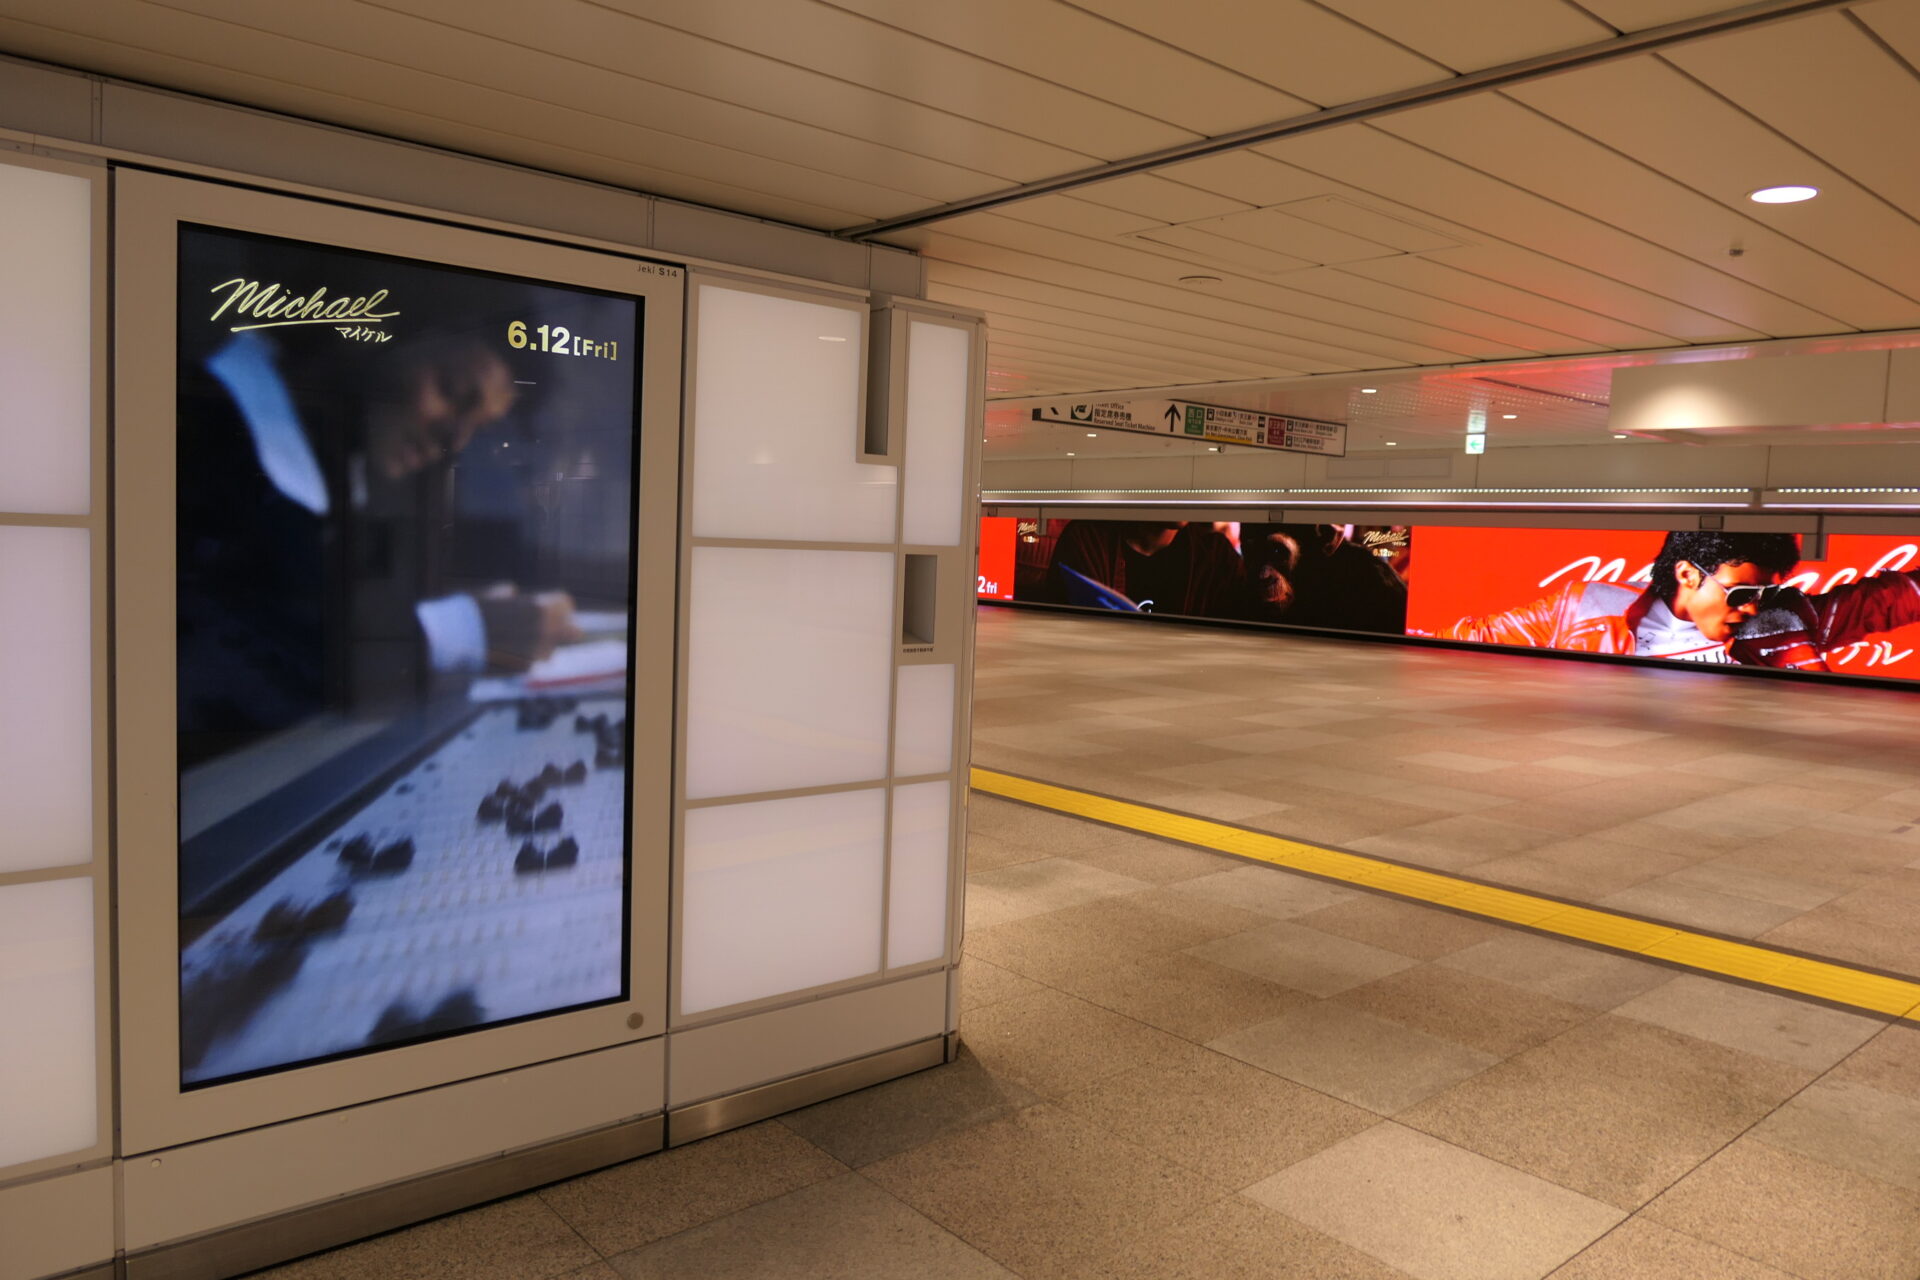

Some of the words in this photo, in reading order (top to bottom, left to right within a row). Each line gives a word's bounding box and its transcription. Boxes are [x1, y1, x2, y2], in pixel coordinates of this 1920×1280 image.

[658, 266, 678, 278] S14
[210, 278, 401, 326] Michael
[334, 325, 393, 344] マイケル
